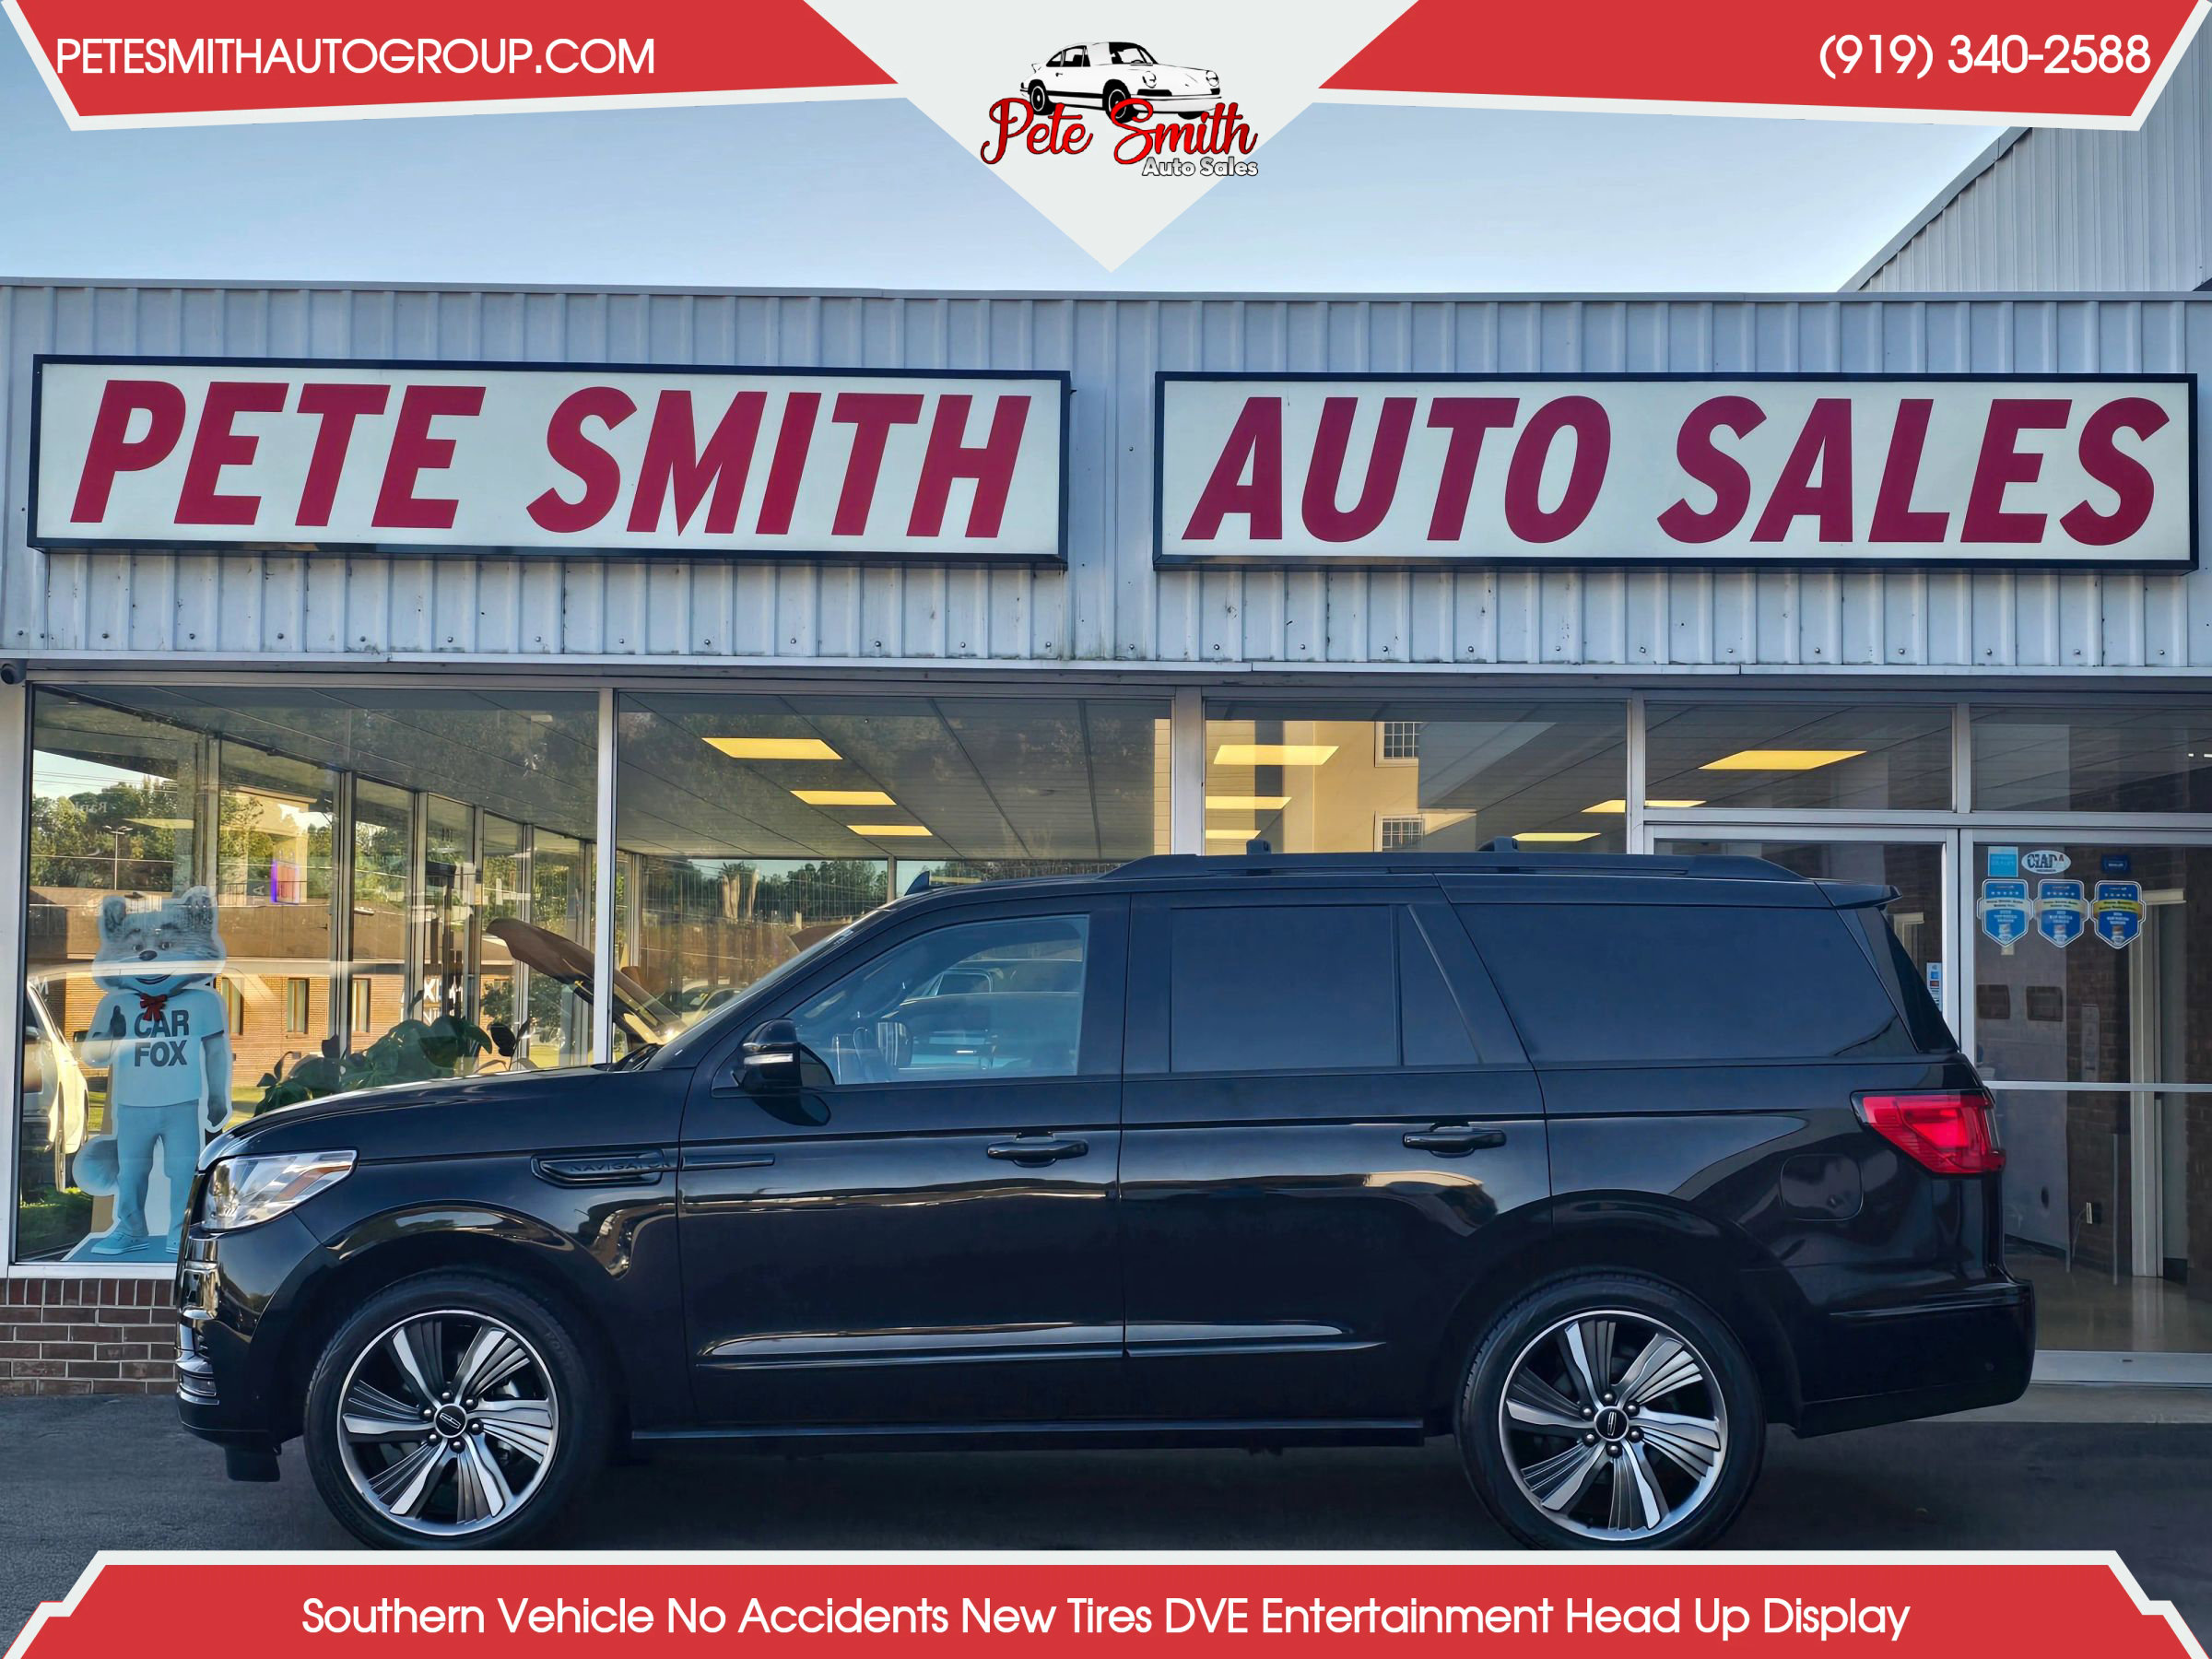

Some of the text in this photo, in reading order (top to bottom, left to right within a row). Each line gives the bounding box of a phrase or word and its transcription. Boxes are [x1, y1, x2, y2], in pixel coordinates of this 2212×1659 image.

[70, 380, 1030, 539] PETE SMITH
[1183, 394, 2170, 546] AUTO SALES
[134, 1009, 189, 1038] CAR
[134, 1040, 188, 1067] FOX
